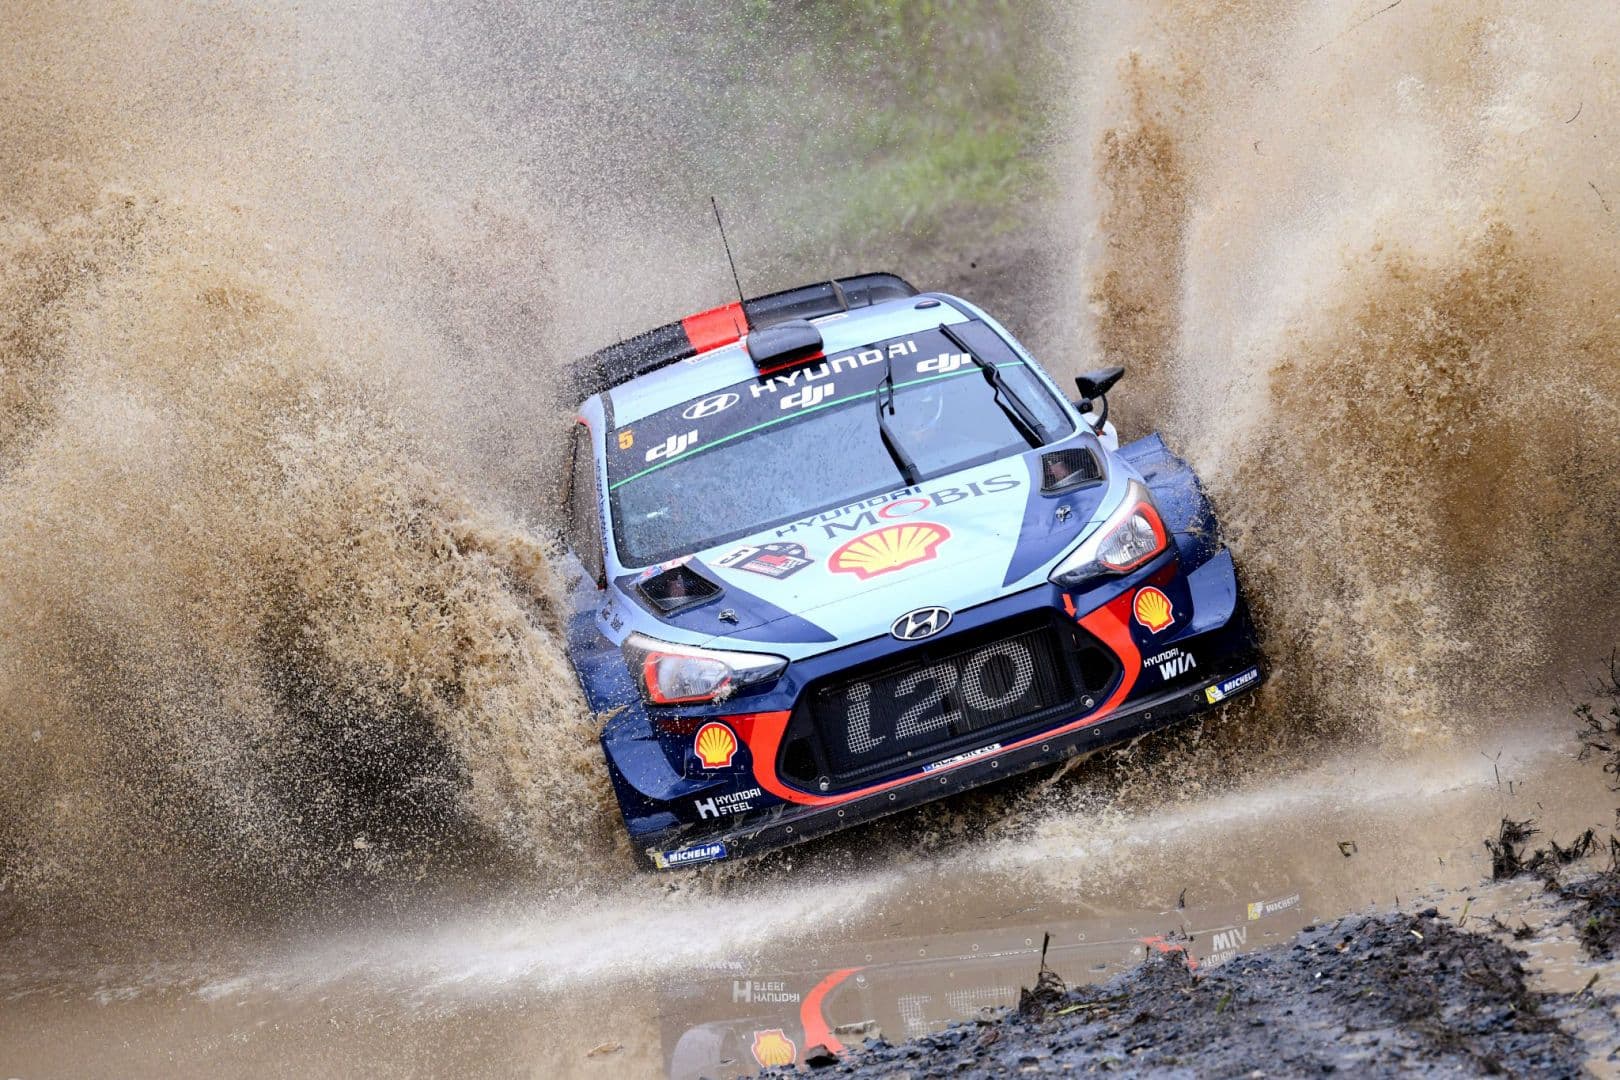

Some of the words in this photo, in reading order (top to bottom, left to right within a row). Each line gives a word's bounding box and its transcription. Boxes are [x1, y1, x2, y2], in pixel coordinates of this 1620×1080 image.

[750, 340, 918, 398] HYUNDAI
[617, 430, 634, 450] 5
[775, 485, 922, 538] HYUNDAI
[821, 474, 1021, 540] MOBIS
[1143, 647, 1180, 668] HYUNDAI
[1223, 668, 1259, 692] MICHELIN
[715, 787, 762, 806] HYUNDAI
[719, 801, 754, 816] STEEL
[669, 845, 720, 863] MICHELIN
